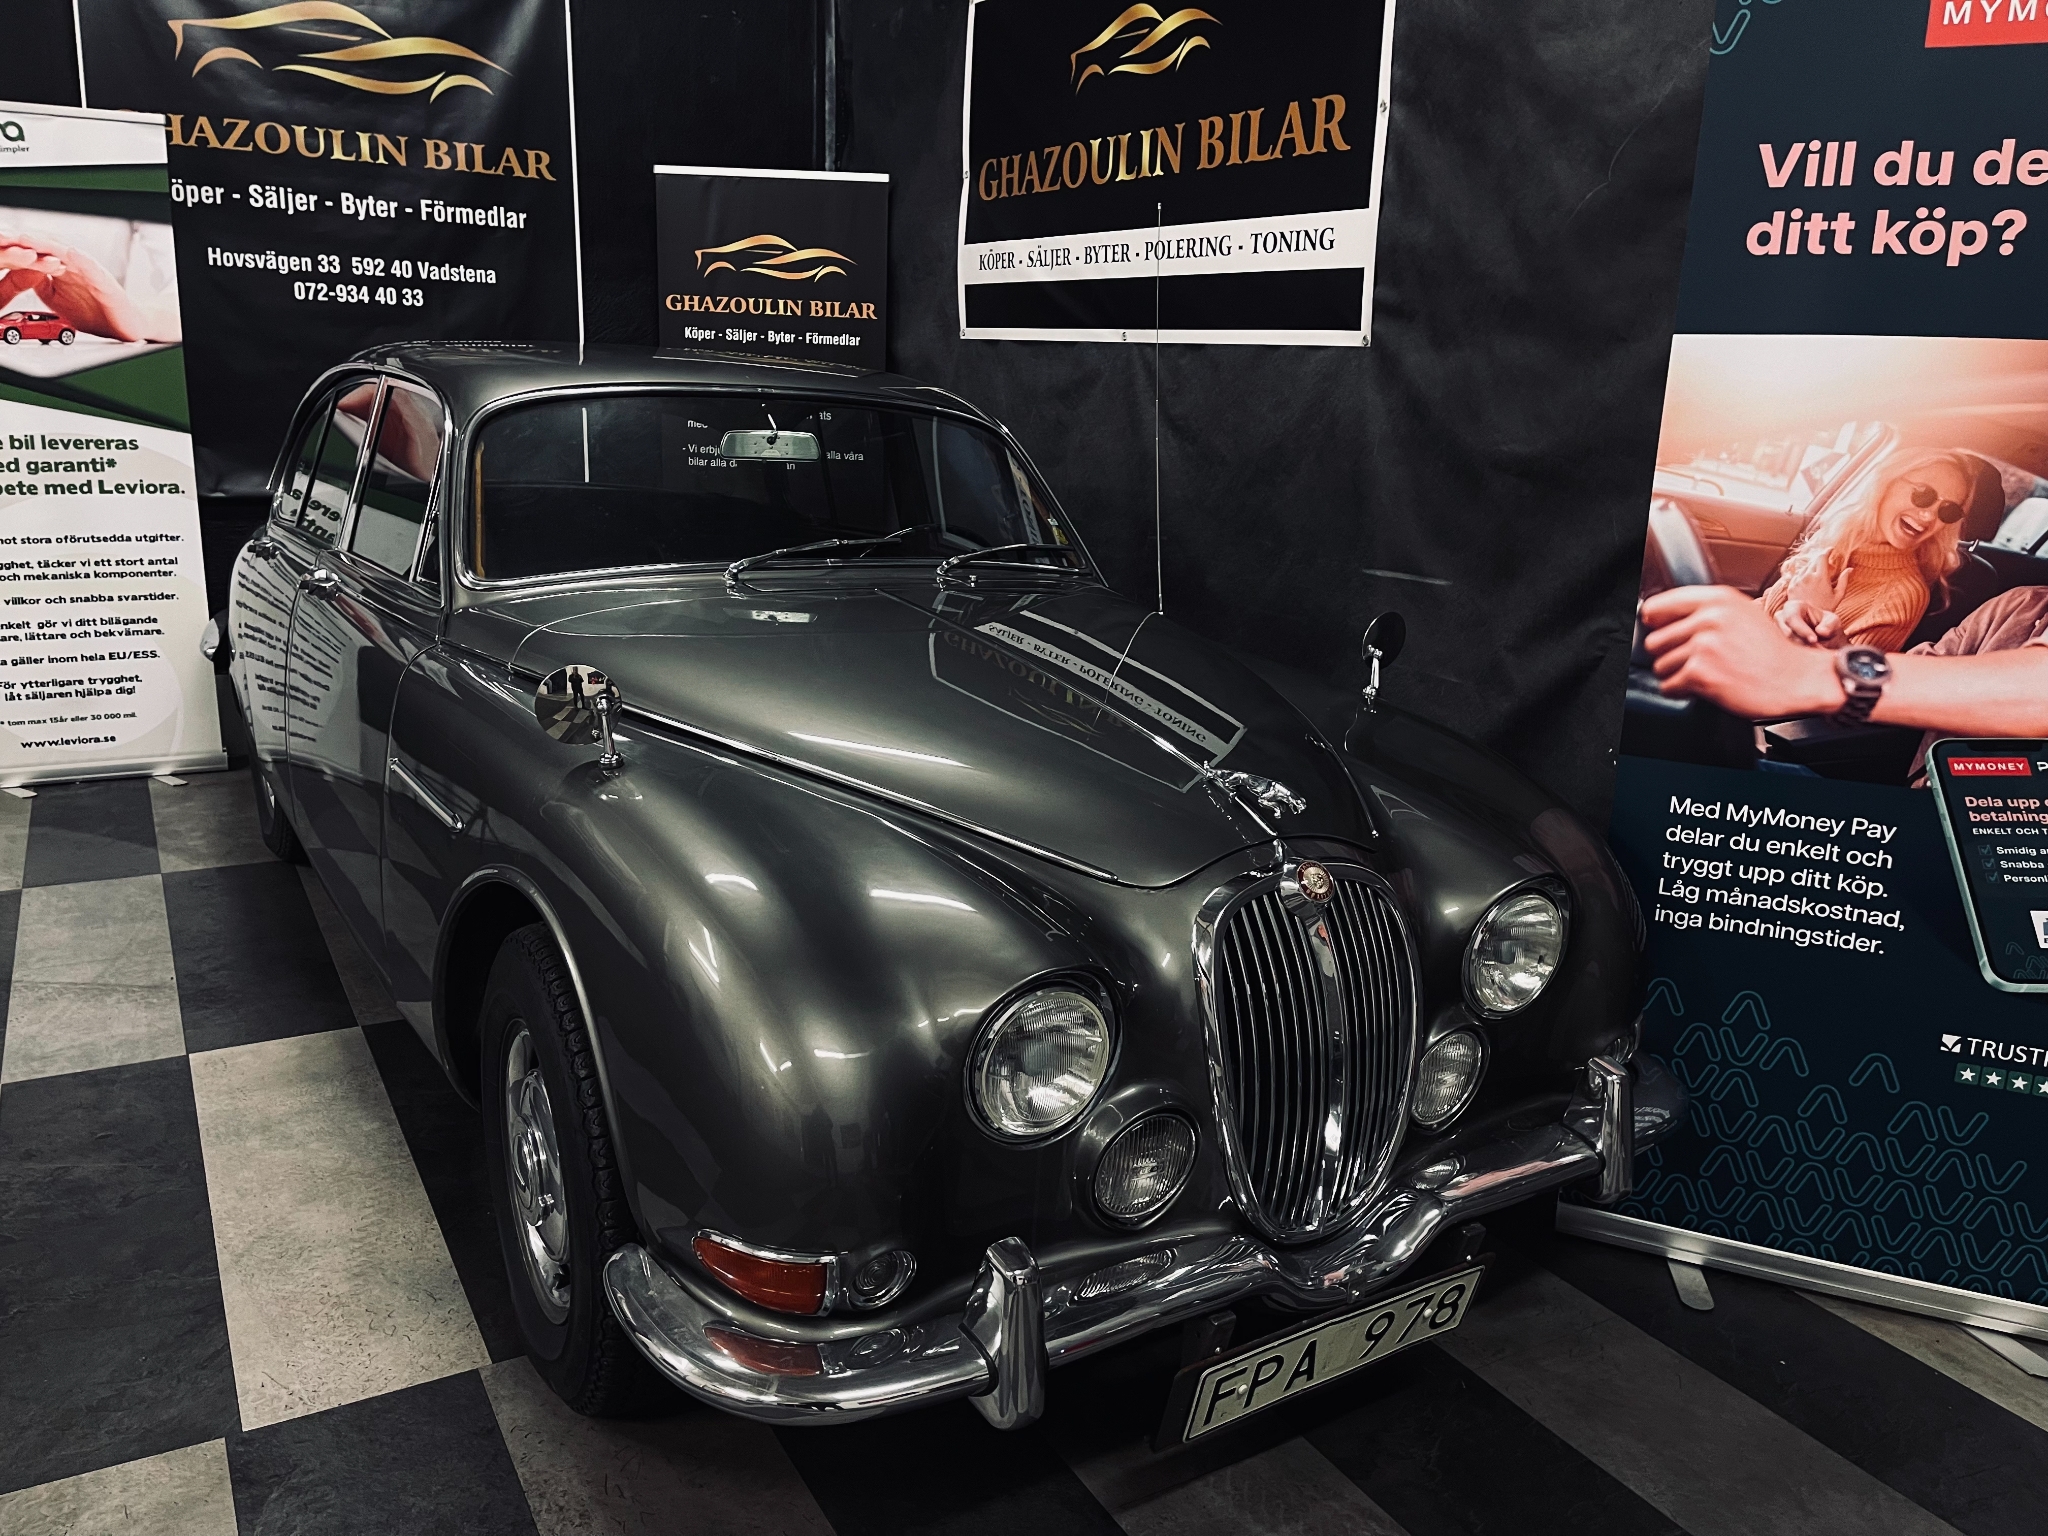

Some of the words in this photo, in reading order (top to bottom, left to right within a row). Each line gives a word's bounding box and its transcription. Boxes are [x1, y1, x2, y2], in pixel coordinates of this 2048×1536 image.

[1943, 0, 2048, 25] MYM
[165, 113, 408, 167] HAZOULIN
[422, 138, 556, 181] BILAR
[978, 122, 1186, 201] GHAZOULIN
[1196, 93, 1351, 170] BILAR
[1759, 139, 1857, 188] Vill
[1873, 140, 1954, 187] du
[171, 178, 225, 208] öper
[249, 184, 318, 215] Säljer
[341, 192, 398, 221] Byter
[420, 199, 527, 229] Förmedlar
[1746, 207, 1855, 256] ditt
[1871, 206, 2028, 267] köp?
[978, 248, 1015, 272] KÖPER
[1026, 244, 1071, 271] SÄLJER
[1083, 242, 1131, 265] BYTER
[1144, 234, 1233, 261] POLERING
[1250, 227, 1336, 255] TONING
[207, 246, 313, 275] Hovsvägen
[317, 254, 341, 274] 33
[351, 257, 385, 277] 592
[390, 259, 412, 279] 40
[417, 260, 497, 284] Vadstena
[293, 281, 370, 304] 072-934
[375, 286, 397, 306] 40
[402, 287, 424, 307] 33
[665, 294, 803, 316] GHAZOULIN
[809, 300, 878, 320] BILAR
[684, 326, 716, 342] Köper
[725, 328, 758, 344] Säljer
[767, 330, 796, 345] Byter
[805, 331, 861, 346] Förmedlar
[9, 434, 35, 450] bil
[41, 434, 139, 450] levereras
[688, 457, 707, 467] bilar
[710, 458, 727, 468] alla
[844, 450, 864, 461] våra
[44, 480, 93, 495] med
[98, 479, 186, 495] Leviora.
[20, 536, 52, 545] stora
[56, 534, 132, 544] oförutsedda
[135, 533, 184, 543] utgifter.
[37, 559, 76, 568] täcker
[80, 558, 91, 567] vi
[94, 558, 112, 567] ett
[115, 557, 144, 566] stort
[147, 557, 178, 566] antal
[23, 571, 91, 581] mekaniska
[93, 569, 177, 579] komponenter.
[4, 596, 41, 605] villkor
[45, 595, 66, 604] och
[69, 594, 114, 604] snabba
[117, 592, 179, 602] svarstider.
[37, 619, 57, 629] gör
[61, 618, 72, 627] vi
[75, 618, 97, 627] ditt
[100, 616, 158, 626] bilägande
[25, 631, 67, 641] lättare
[70, 630, 91, 639] och
[94, 627, 165, 638] bekvämare.
[11, 655, 45, 667] gäller
[48, 654, 78, 664] inom
[80, 652, 105, 662] hela
[108, 650, 161, 661] EU/ESS.
[20, 678, 84, 689] ytterligare
[88, 674, 142, 685] trygghet,
[5, 691, 22, 702] låt
[25, 689, 73, 701] säljaren
[75, 686, 112, 698] hjälpa
[115, 686, 136, 696] dig!
[21, 734, 116, 749] www.leviora.se
[1953, 762, 2025, 772] MYMONEY
[1965, 796, 2003, 808] Dela
[2007, 798, 2040, 810] upp
[1669, 796, 1721, 819] Med
[1726, 803, 1845, 837] MyMoney
[1850, 817, 1897, 844] Pay
[1972, 827, 2012, 835] ENKELT
[2015, 827, 2040, 835] OCH
[1666, 825, 1724, 847] delar
[1729, 833, 1760, 852] du
[1766, 839, 1840, 863] enkelt
[1846, 850, 1893, 869] och
[1996, 846, 2037, 857] Smidig
[2000, 861, 2045, 869] Snabba
[1663, 851, 1733, 880] tryggt
[1739, 864, 1785, 886] upp
[1791, 868, 1832, 890] ditt
[1837, 873, 1888, 900] köp.
[1658, 877, 1700, 904] Låg
[1706, 886, 1905, 932] månadskostnad,
[1654, 904, 1703, 930] inga
[1709, 912, 1884, 955] bindningstider.
[1967, 1037, 2048, 1067] TRUST
[1202, 1338, 1318, 1427] FPA
[1358, 1283, 1467, 1359] 978
